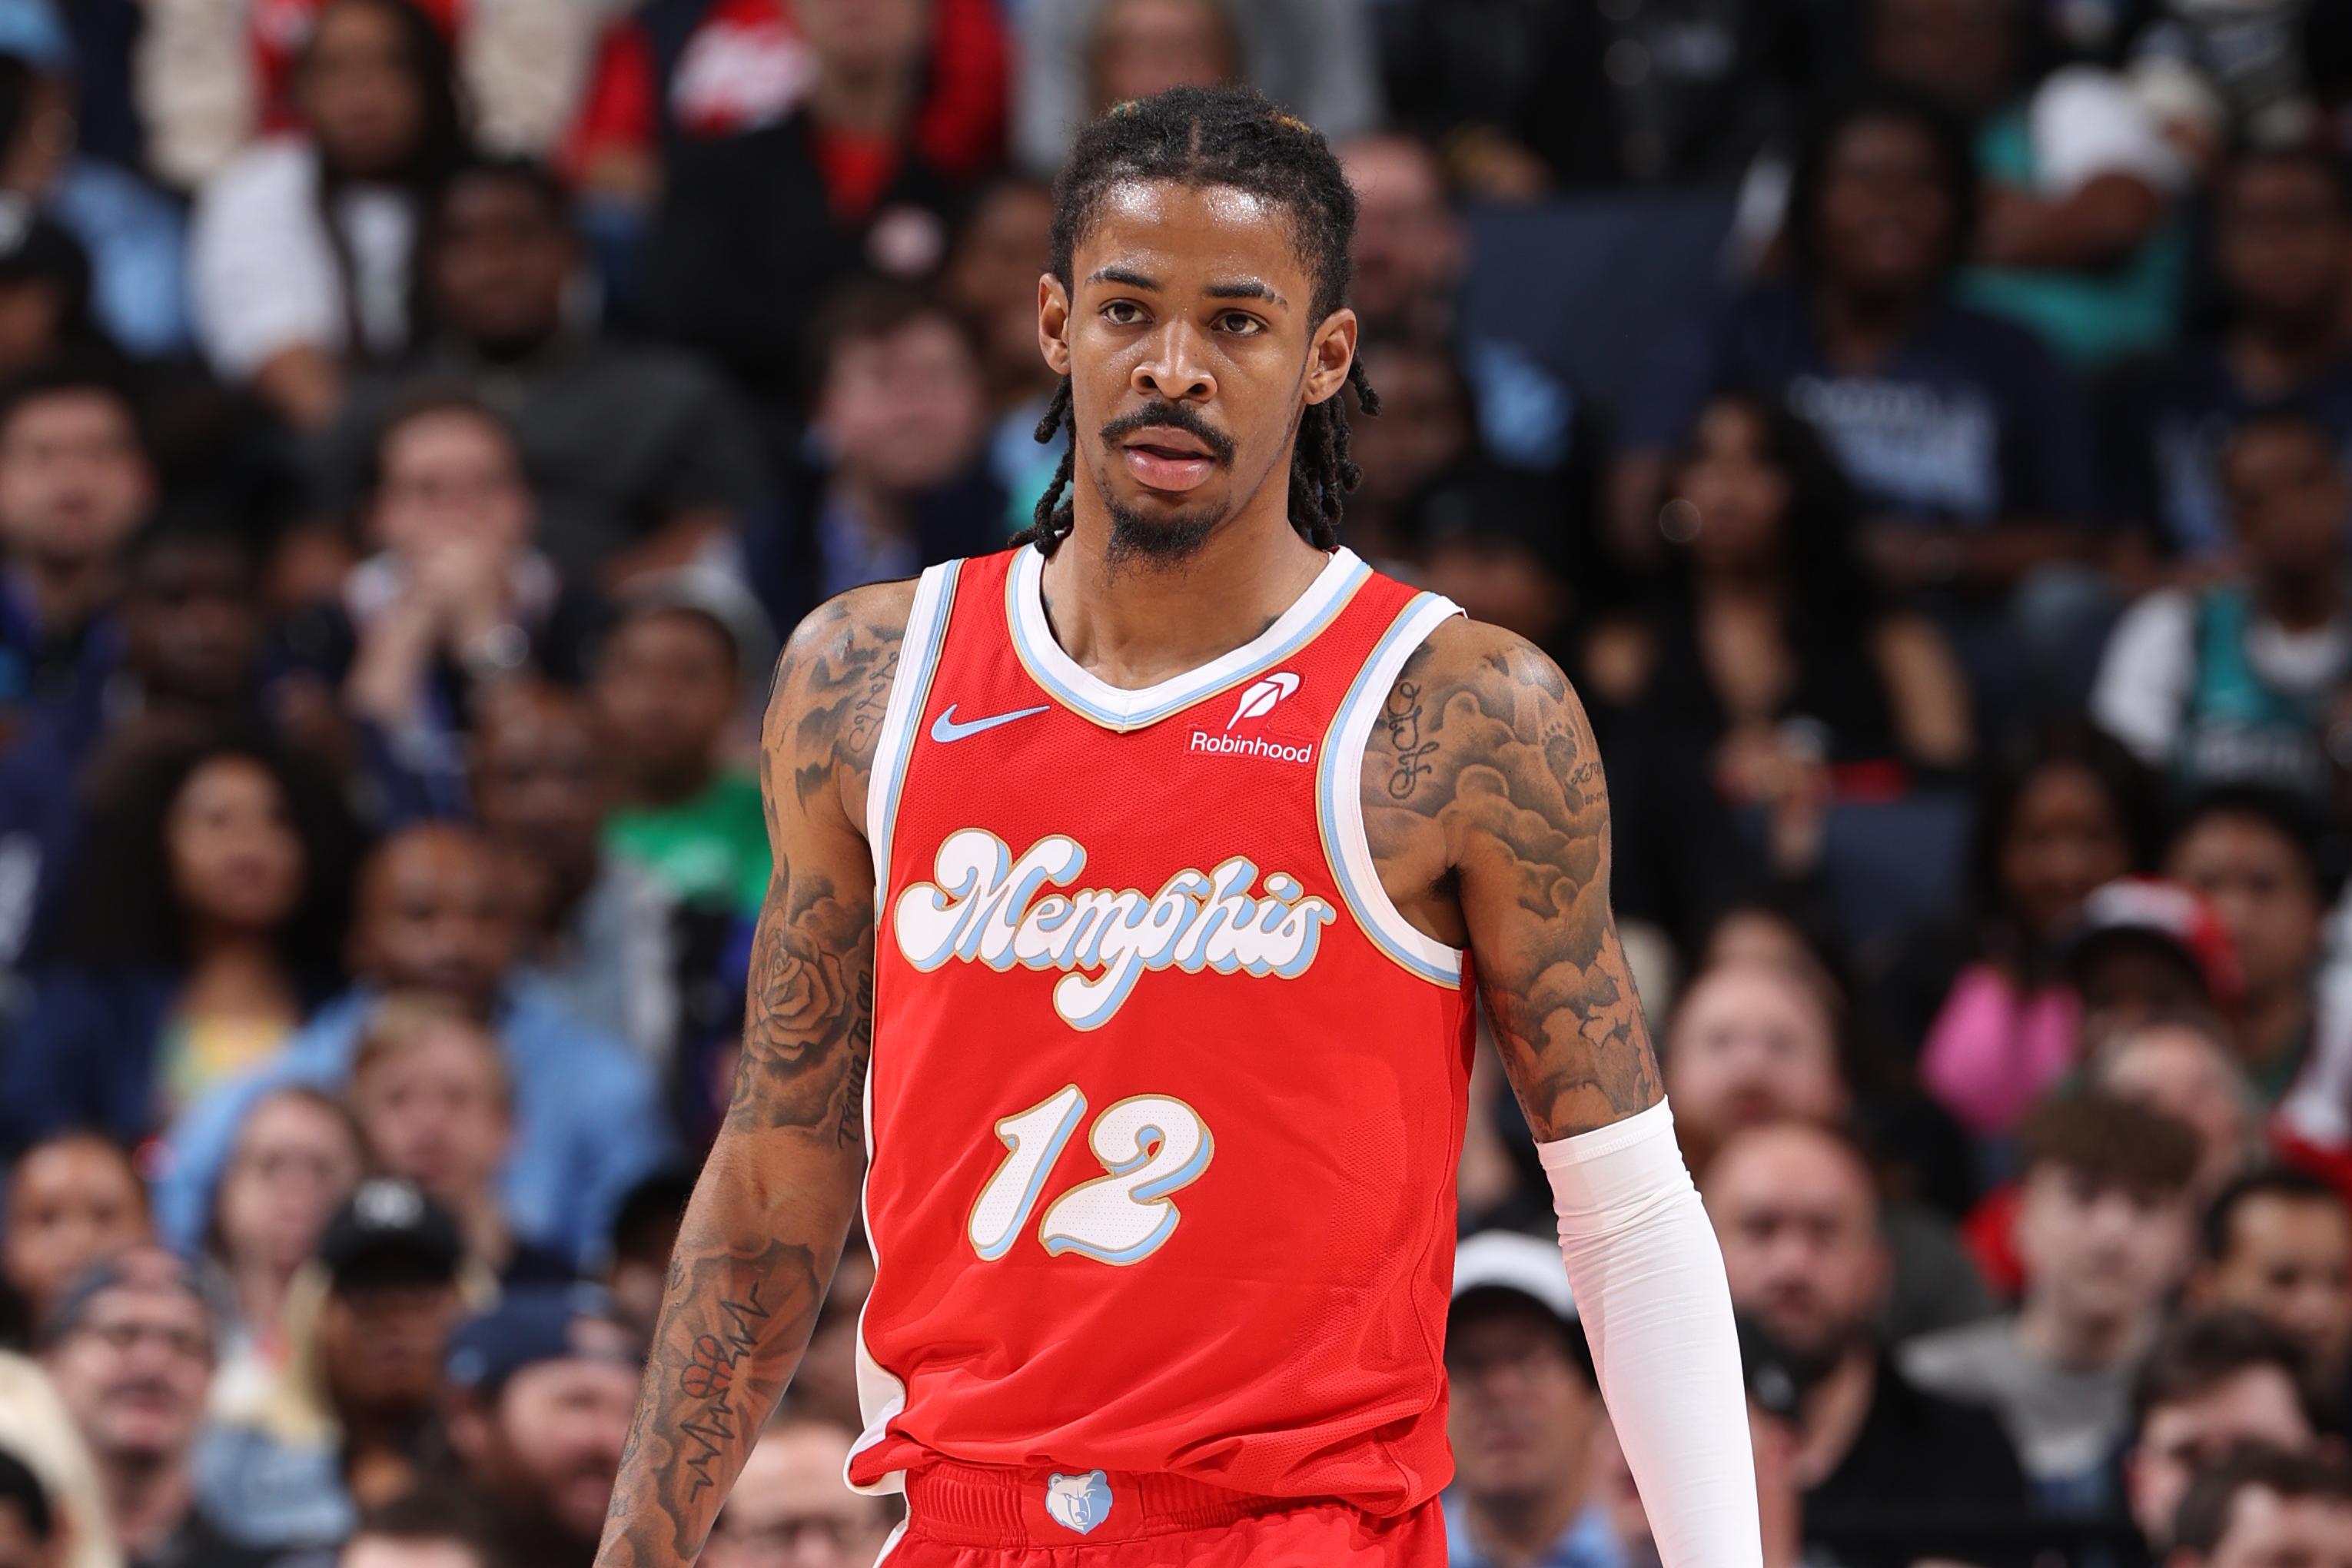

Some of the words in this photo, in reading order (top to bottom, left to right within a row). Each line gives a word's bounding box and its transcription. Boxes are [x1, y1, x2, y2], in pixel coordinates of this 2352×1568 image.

[1191, 731, 1313, 763] Robinhood
[896, 828, 1337, 1031] Memphis
[968, 1083, 1214, 1266] 12
